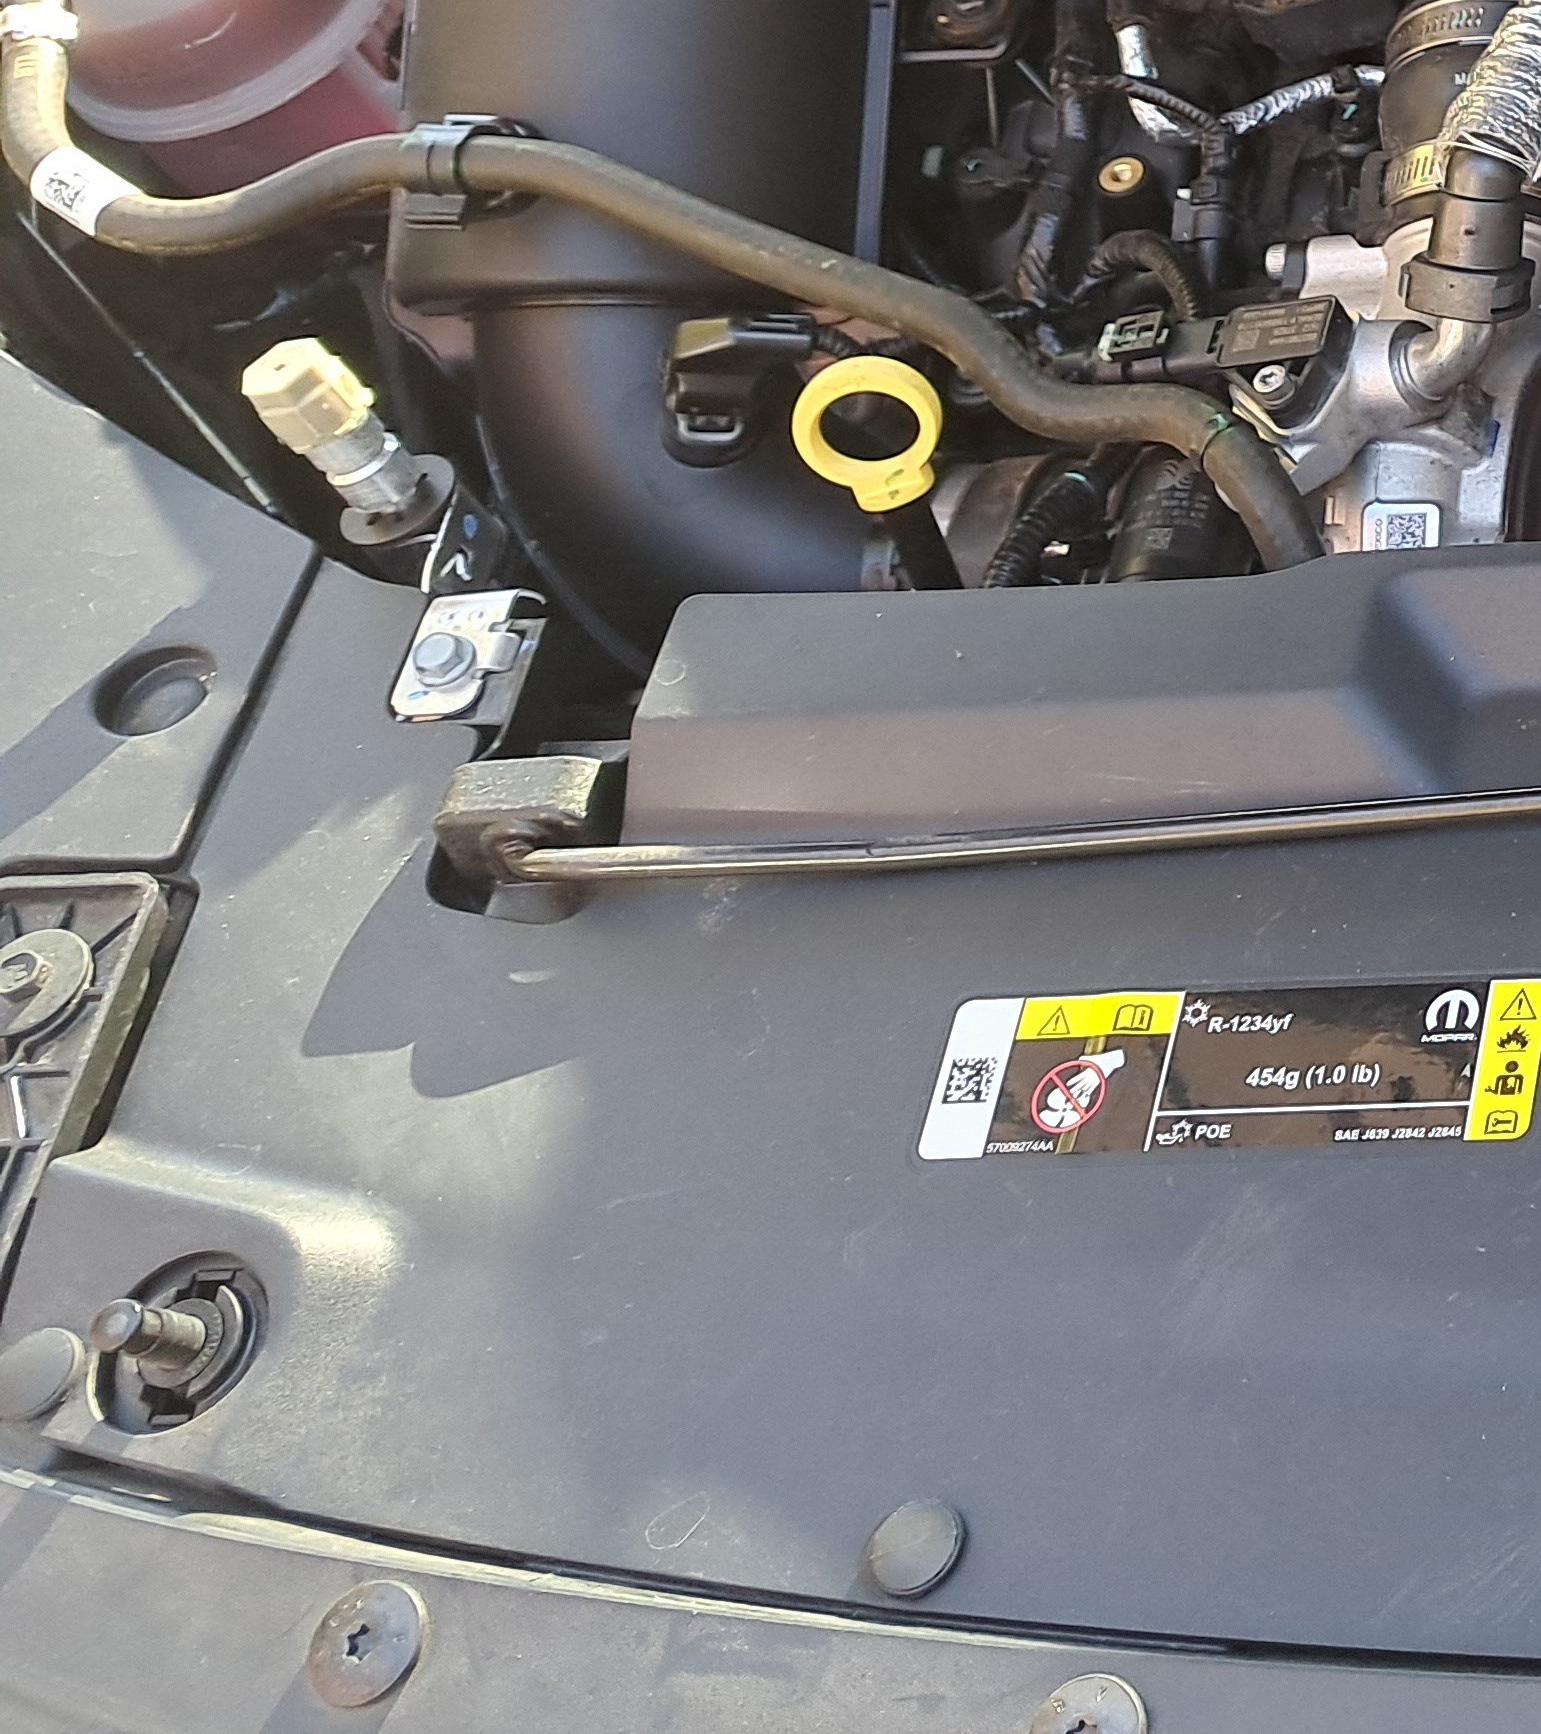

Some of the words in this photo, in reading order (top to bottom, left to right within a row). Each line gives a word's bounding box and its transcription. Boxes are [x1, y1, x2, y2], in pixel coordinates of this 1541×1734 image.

[1207, 1013, 1295, 1035] R-1234yf
[1245, 1067, 1300, 1090] 454g
[1305, 1065, 1346, 1090] (1.0
[1352, 1063, 1381, 1088] lb)
[1195, 1123, 1232, 1140] POE
[1334, 1129, 1360, 1141] SAE
